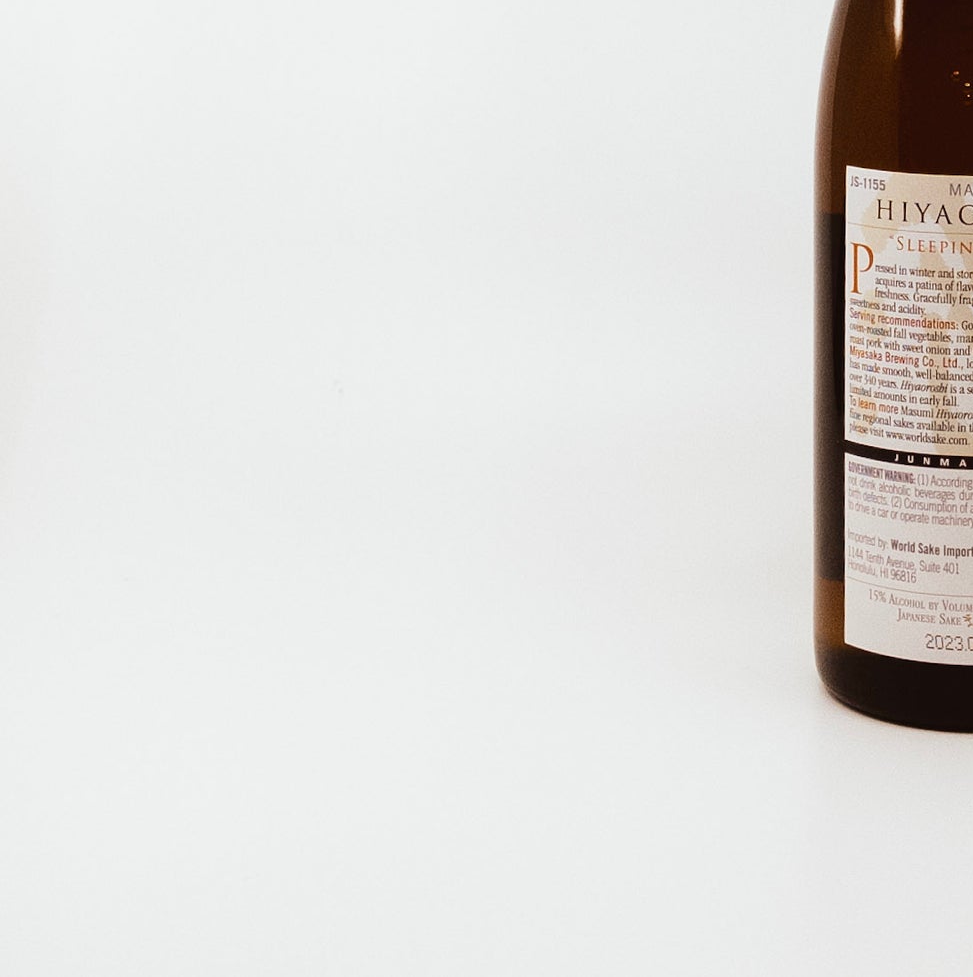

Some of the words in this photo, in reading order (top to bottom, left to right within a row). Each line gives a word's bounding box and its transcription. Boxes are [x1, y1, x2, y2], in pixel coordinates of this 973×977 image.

[851, 176, 886, 191] JS-1155
[899, 265, 907, 275] in
[909, 267, 934, 277] winter
[938, 268, 954, 278] and
[875, 277, 906, 289] acquires
[916, 282, 942, 293] patina
[945, 281, 954, 291] of
[913, 293, 956, 306] Gracefully
[882, 302, 895, 312] and
[898, 304, 926, 317] acidity.
[850, 308, 875, 323] Serving
[878, 314, 958, 329] recommendations:
[894, 327, 906, 338] fall
[909, 330, 953, 343] vegetables,
[866, 338, 881, 349] pork
[884, 339, 900, 350] with
[902, 342, 923, 352] sweet
[926, 345, 951, 355] onion
[954, 345, 970, 355] and
[850, 345, 882, 361] Miyasaka
[885, 352, 919, 367] Brewing
[922, 356, 939, 368] Co.,
[862, 362, 880, 373] made
[882, 365, 913, 379] smooth,
[916, 369, 973, 381] well-balanced
[850, 373, 862, 383] over
[901, 380, 948, 393] Hiyaoroshi
[950, 384, 956, 393] is
[874, 390, 906, 402] amounts
[909, 393, 917, 403] in
[919, 395, 938, 407] early
[858, 398, 876, 411] learn
[879, 403, 898, 415] more
[901, 407, 934, 418] Masumi
[862, 414, 891, 425] regional
[893, 418, 914, 428] sakes
[916, 421, 955, 433] available
[958, 423, 965, 433] in
[870, 427, 884, 437] visit
[848, 461, 883, 478] GOVERNMENT
[885, 469, 915, 484] WARNING:
[917, 473, 929, 486] (1)
[931, 475, 972, 489] According
[879, 484, 912, 496] alcoholic
[915, 488, 955, 501] beverages
[863, 492, 889, 505] defects.
[891, 496, 902, 509] (2)
[904, 498, 957, 513] Consumption
[960, 501, 968, 513] of
[854, 501, 870, 515] drive
[878, 508, 888, 517] car
[900, 512, 929, 524] operate
[848, 529, 875, 546] Imported
[891, 539, 915, 553] World
[918, 543, 940, 555] Sake
[848, 545, 863, 559] 1144
[866, 550, 884, 565] Tenth
[886, 556, 916, 571] Avenue,
[919, 560, 940, 573] Suite
[943, 563, 960, 575] 401
[880, 568, 888, 578] HI
[892, 569, 916, 583] 96816
[869, 589, 886, 603] 15%
